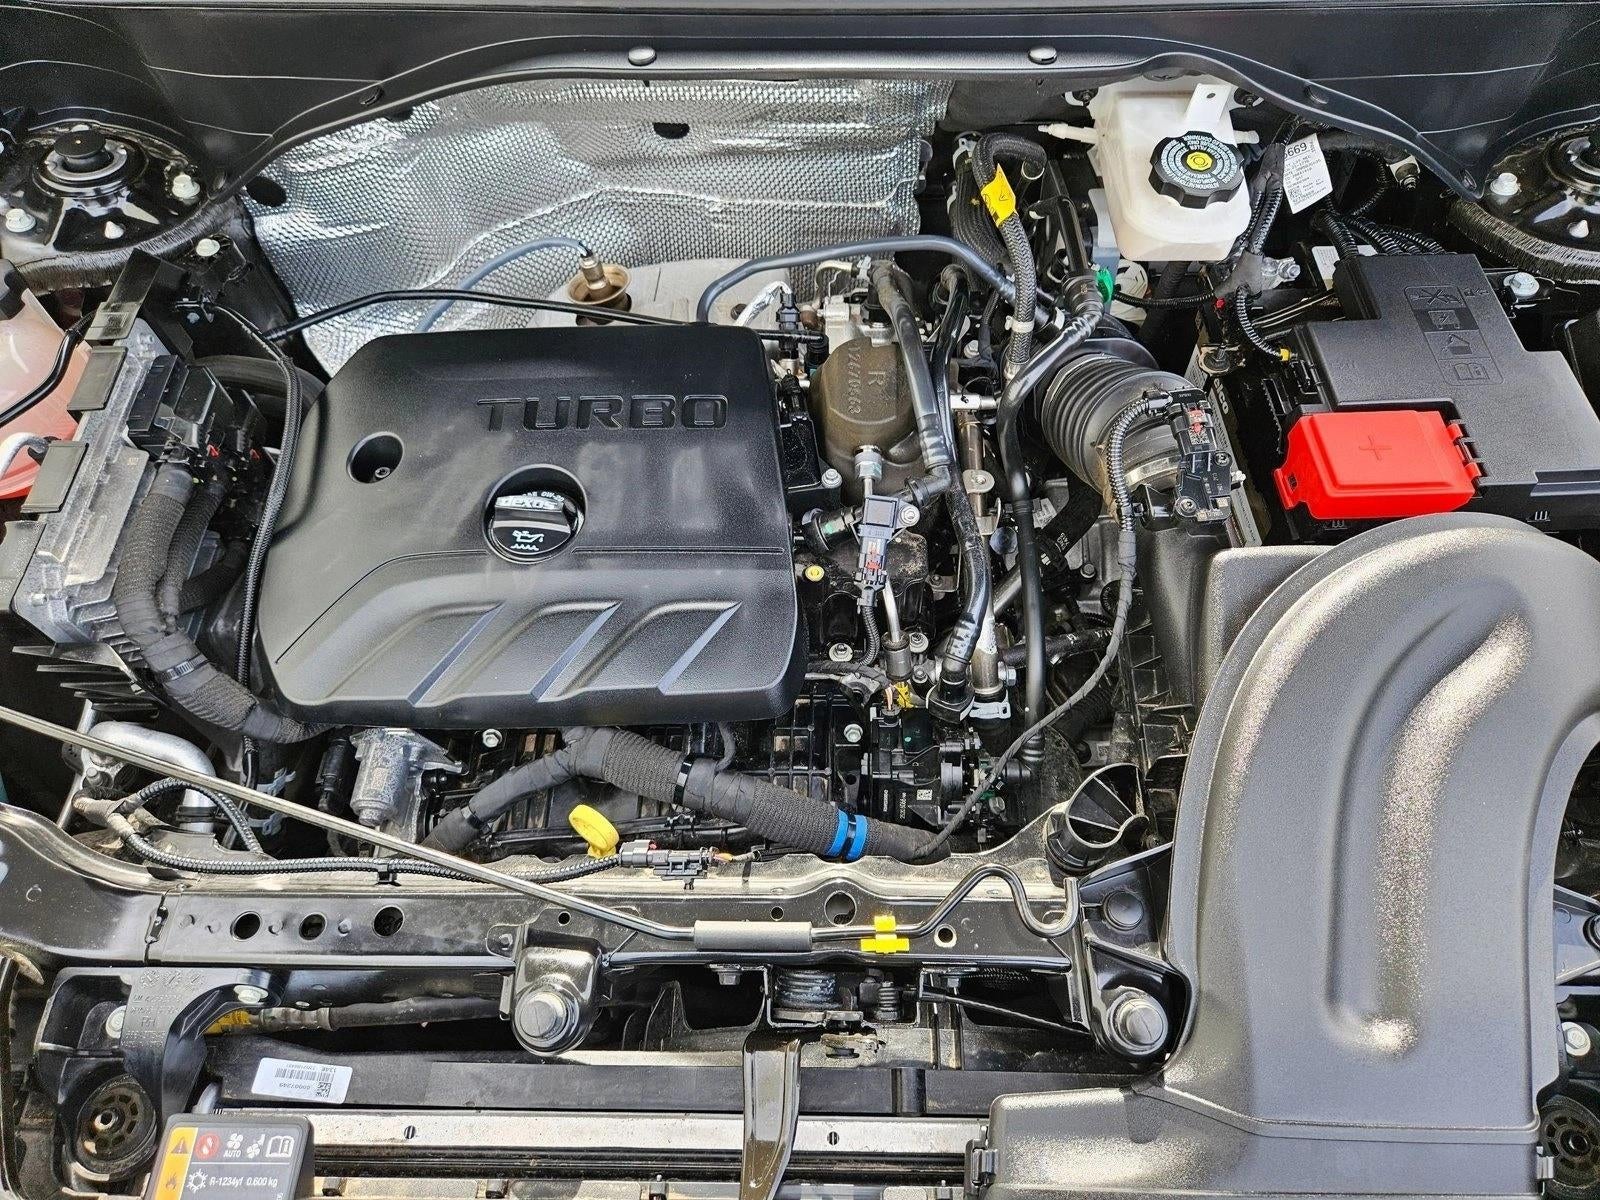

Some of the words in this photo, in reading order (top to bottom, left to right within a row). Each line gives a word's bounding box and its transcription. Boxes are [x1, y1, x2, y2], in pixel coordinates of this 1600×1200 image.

[1284, 142, 1308, 159] 669
[1213, 377, 1229, 415] elco
[477, 394, 729, 432] TURBO
[223, 1150, 242, 1158] AUTO
[209, 1176, 244, 1188] R-1234yf
[246, 1177, 267, 1187] 0.600
[268, 1177, 278, 1188] kg
